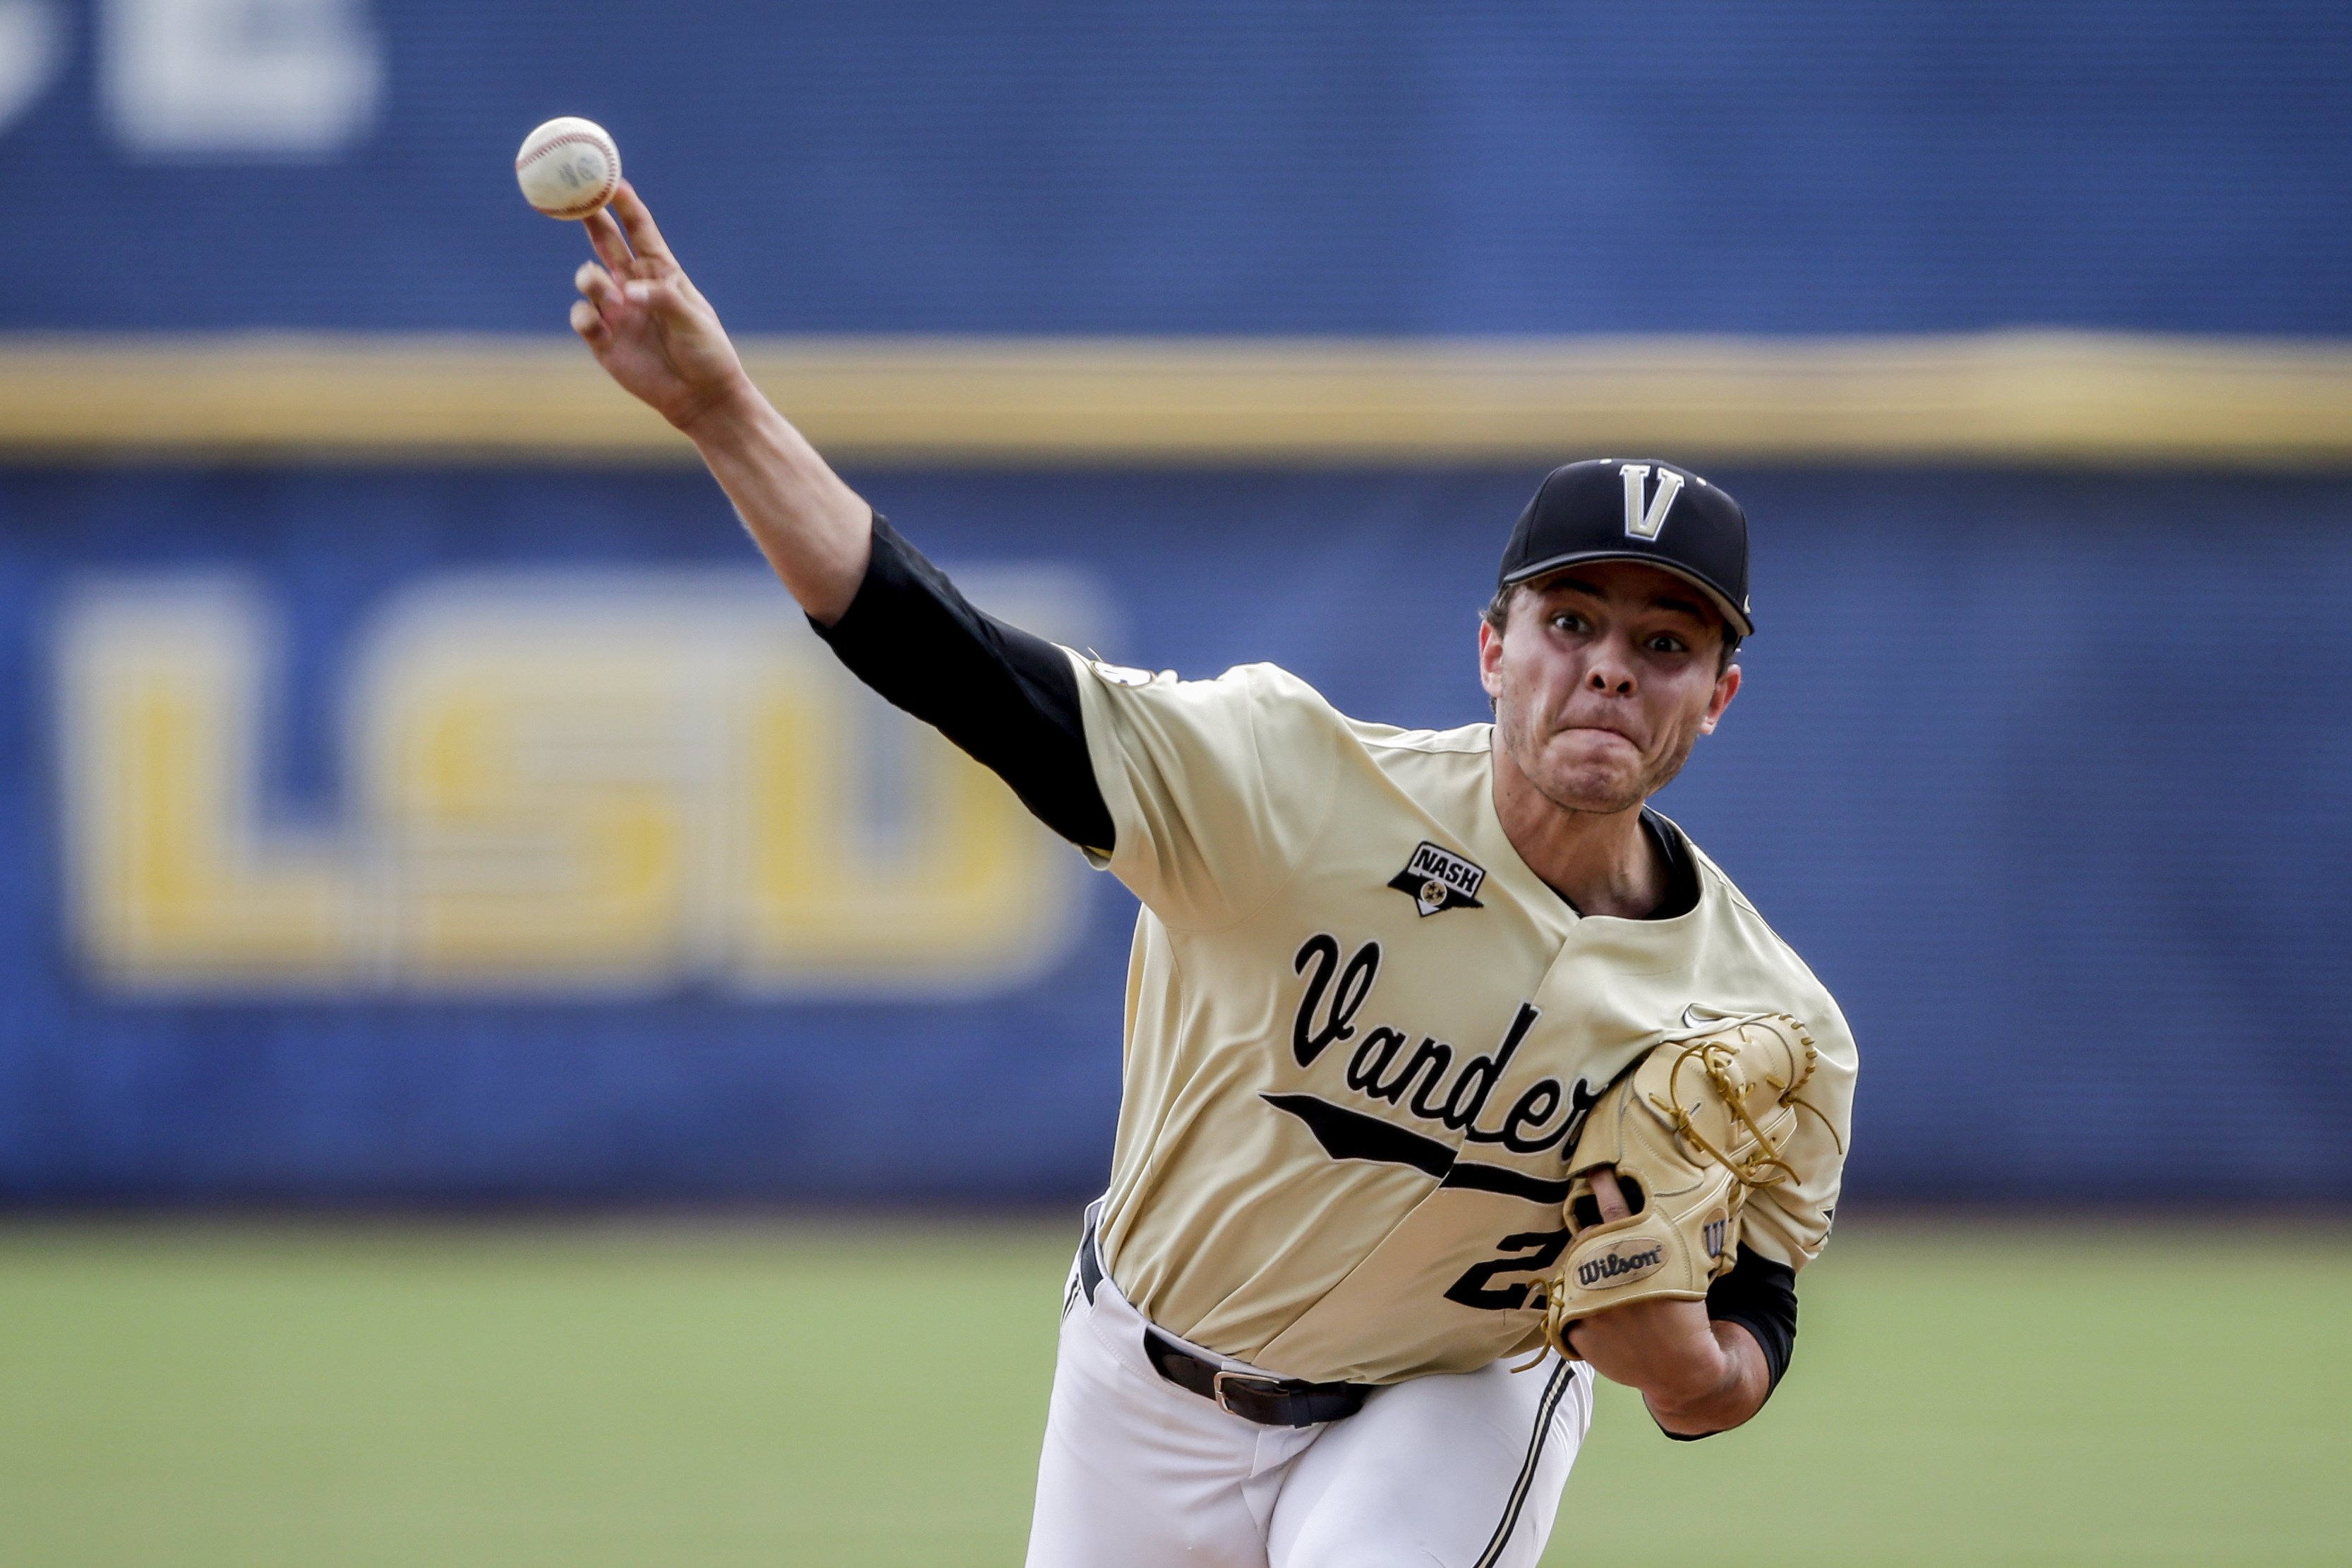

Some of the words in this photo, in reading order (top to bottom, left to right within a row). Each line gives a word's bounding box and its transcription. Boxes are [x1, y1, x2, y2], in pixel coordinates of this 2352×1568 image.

[1620, 464, 1684, 541] V
[60, 566, 1114, 994] LSU
[1414, 848, 1479, 892] NASH
[1578, 1247, 1662, 1286] Wilson
